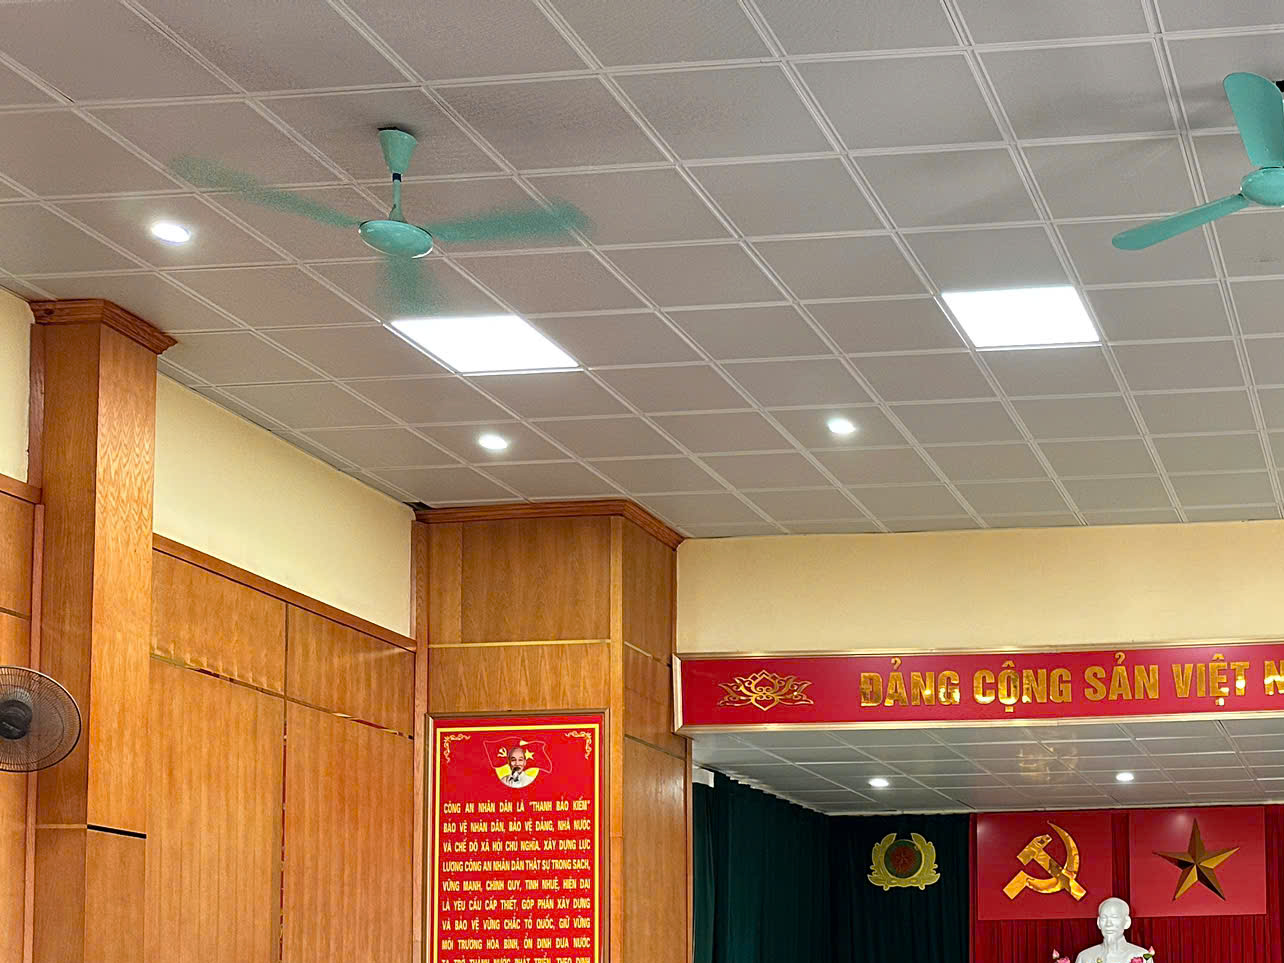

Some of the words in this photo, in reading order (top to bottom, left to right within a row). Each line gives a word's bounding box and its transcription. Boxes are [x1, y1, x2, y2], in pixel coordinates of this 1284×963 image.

[859, 658, 961, 706] ĐẢNG
[972, 660, 1073, 712] CỘNG
[1084, 652, 1160, 701] SẢN
[1172, 653, 1250, 706] VIỆT
